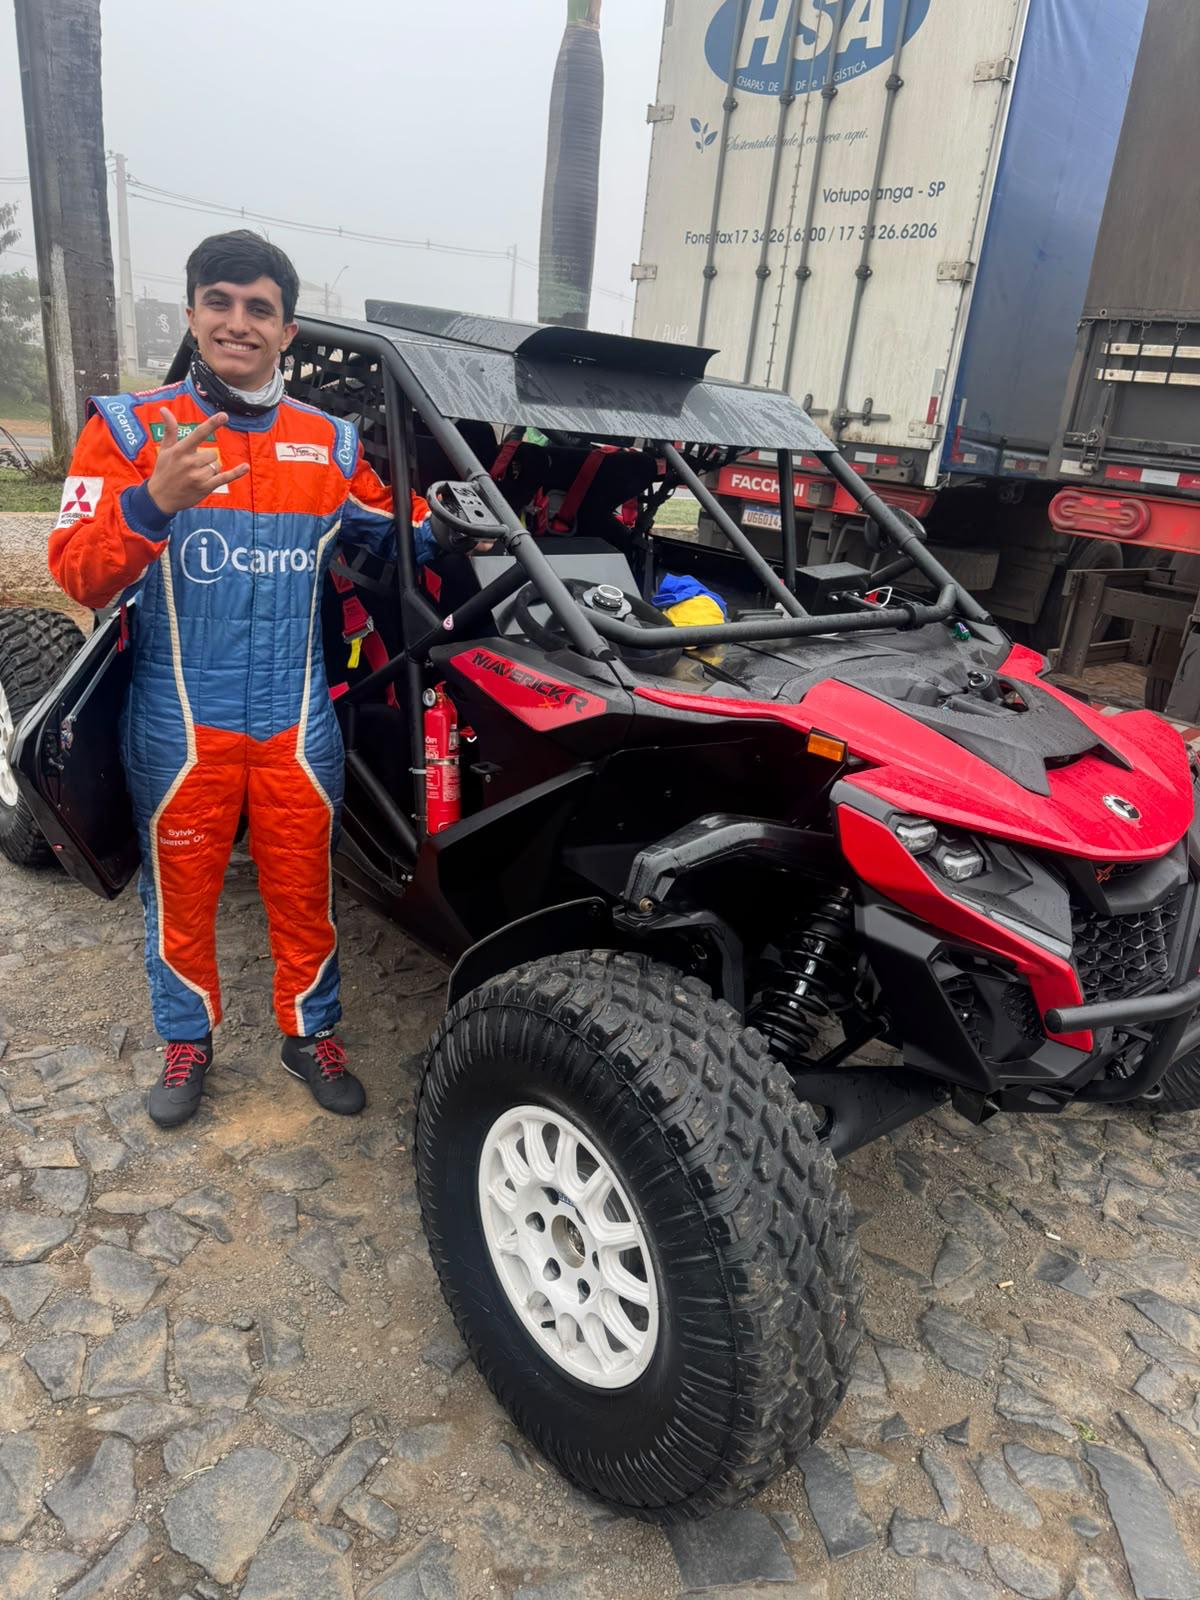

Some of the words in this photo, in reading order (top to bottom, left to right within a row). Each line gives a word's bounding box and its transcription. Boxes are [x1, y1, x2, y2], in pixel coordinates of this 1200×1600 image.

[735, 0, 884, 70] HSA
[736, 75, 765, 91] CHAPAS
[768, 80, 780, 91] DE
[822, 60, 867, 86] LGÍSTICA
[823, 186, 914, 205] Votupoanga
[928, 181, 945, 197] SP
[839, 225, 854, 241] 17
[472, 652, 567, 702] MAVERICK
